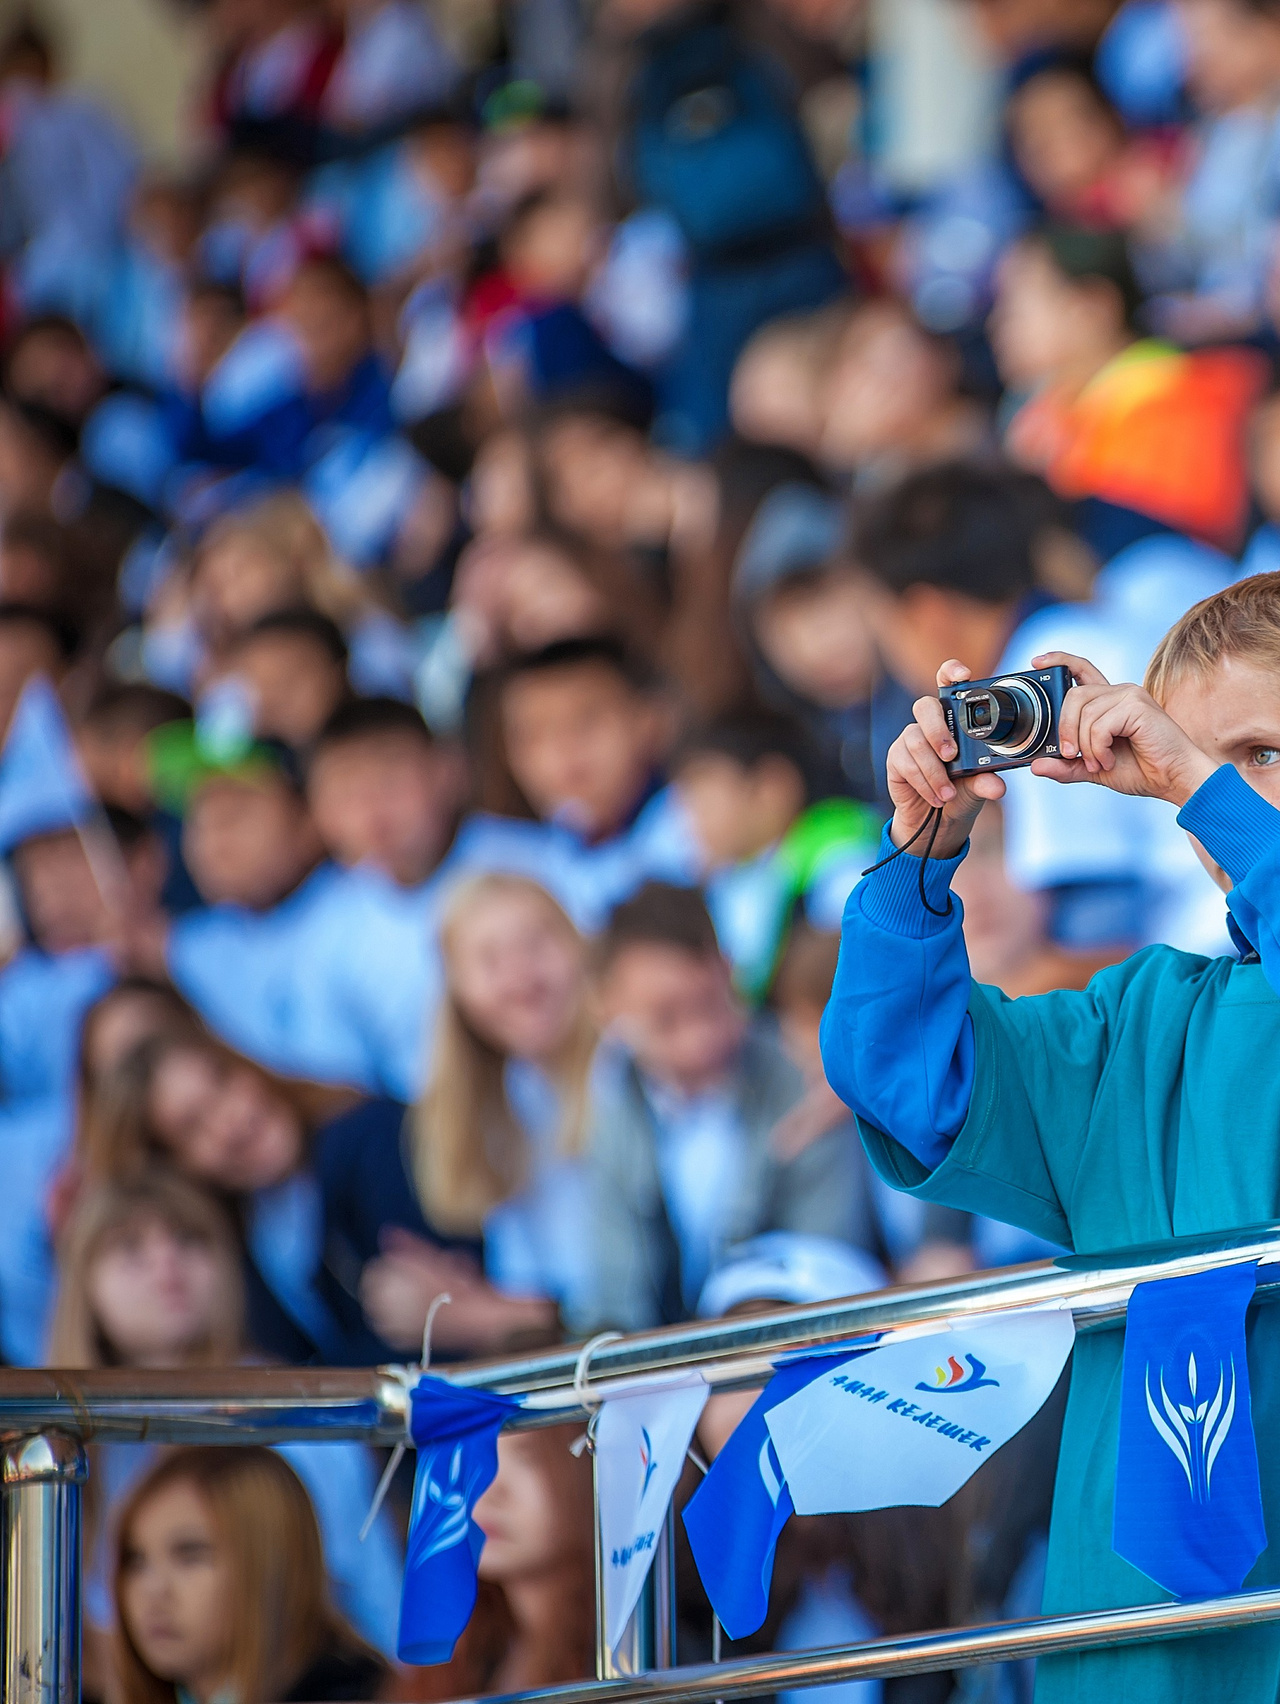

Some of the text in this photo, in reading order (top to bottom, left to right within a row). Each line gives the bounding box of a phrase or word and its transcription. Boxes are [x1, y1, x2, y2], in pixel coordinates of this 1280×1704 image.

[1040, 674, 1051, 682] HD
[829, 1375, 992, 1452] АМАН КЕЛЕШЕК
